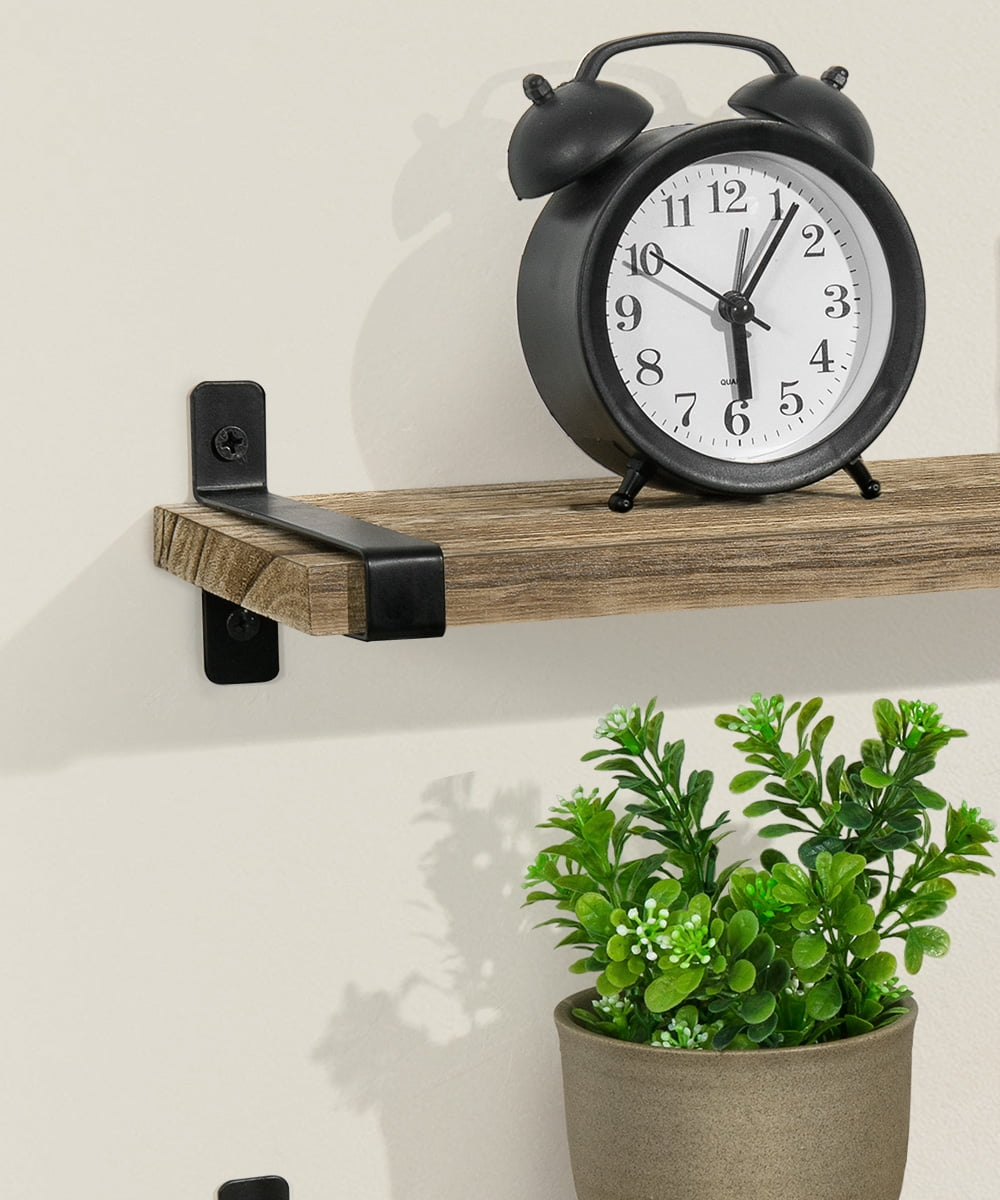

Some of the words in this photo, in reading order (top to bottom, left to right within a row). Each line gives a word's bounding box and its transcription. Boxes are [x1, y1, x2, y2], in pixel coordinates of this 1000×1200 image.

[661, 194, 695, 228] 11
[707, 180, 748, 214] 12
[769, 188, 784, 221] 1
[801, 224, 826, 258] 2
[625, 242, 664, 277] 10
[615, 295, 642, 332] 9
[824, 285, 850, 319] 3
[636, 349, 664, 386] 8
[809, 339, 835, 374] 4
[675, 393, 697, 427] 7
[780, 381, 803, 416] 5
[724, 399, 750, 436] 6
